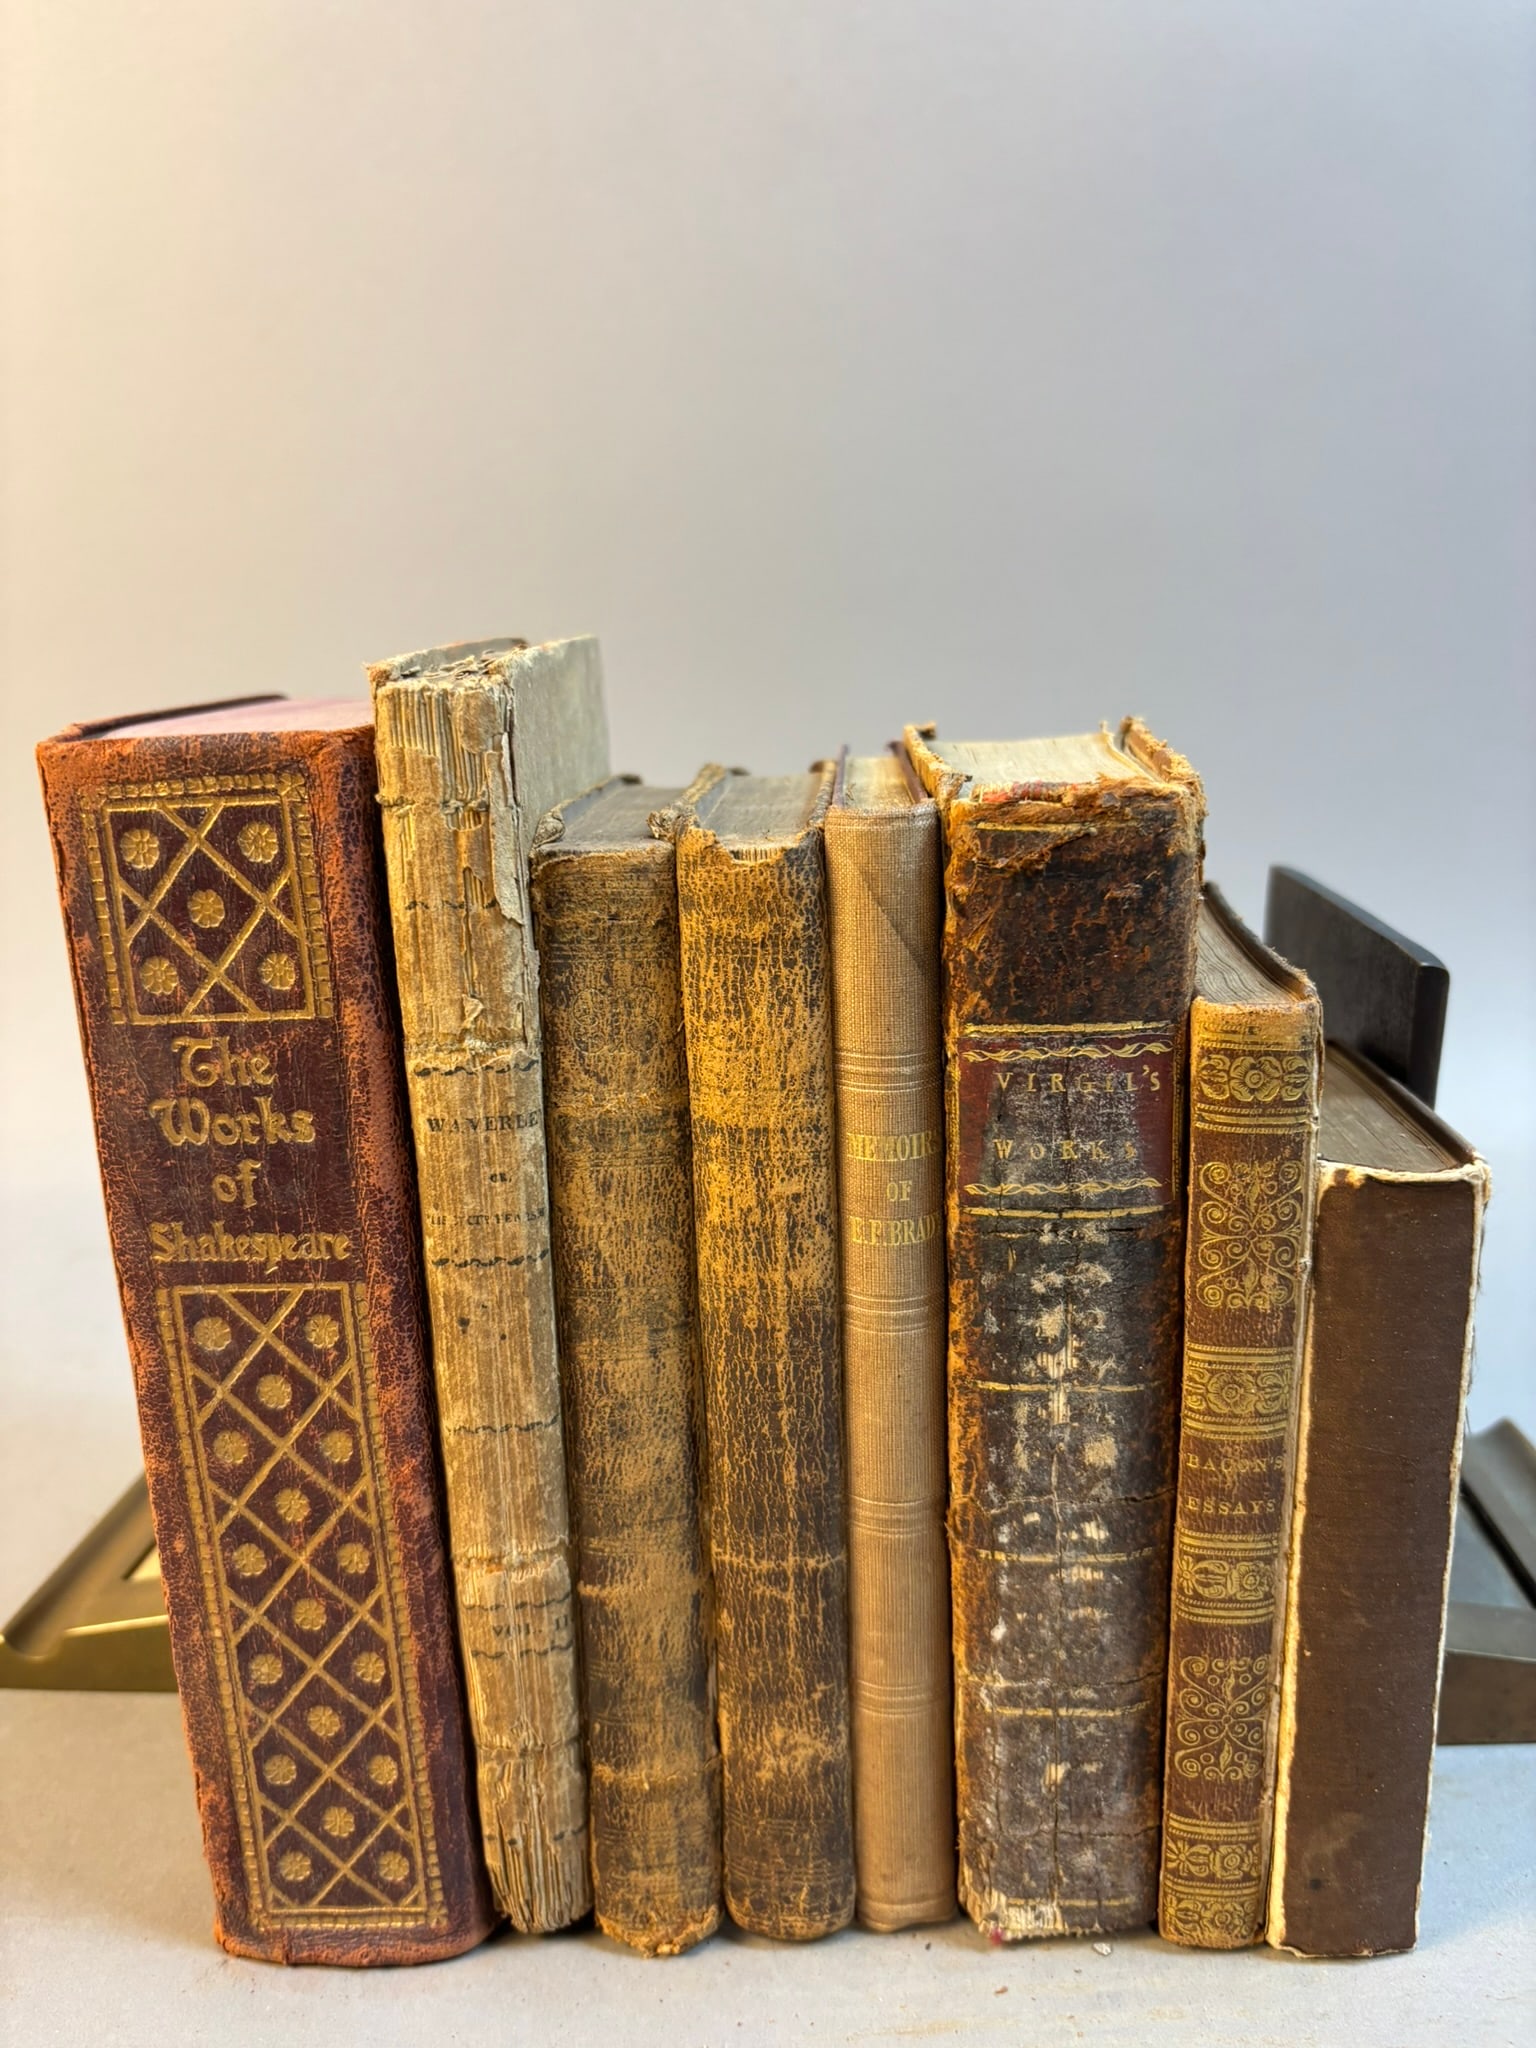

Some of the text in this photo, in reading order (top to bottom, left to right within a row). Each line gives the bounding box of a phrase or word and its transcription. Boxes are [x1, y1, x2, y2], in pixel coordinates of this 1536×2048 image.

[172, 1035, 277, 1088] The
[995, 1064, 1161, 1094] VIRGIL'S
[150, 1095, 316, 1146] Works
[993, 1138, 1137, 1161] WORKS
[213, 1159, 262, 1208] of
[886, 1180, 912, 1202] OF
[151, 1221, 351, 1275] Shakespeare
[1186, 1453, 1283, 1473] BACON'S
[1185, 1496, 1276, 1515] ESSAYS
